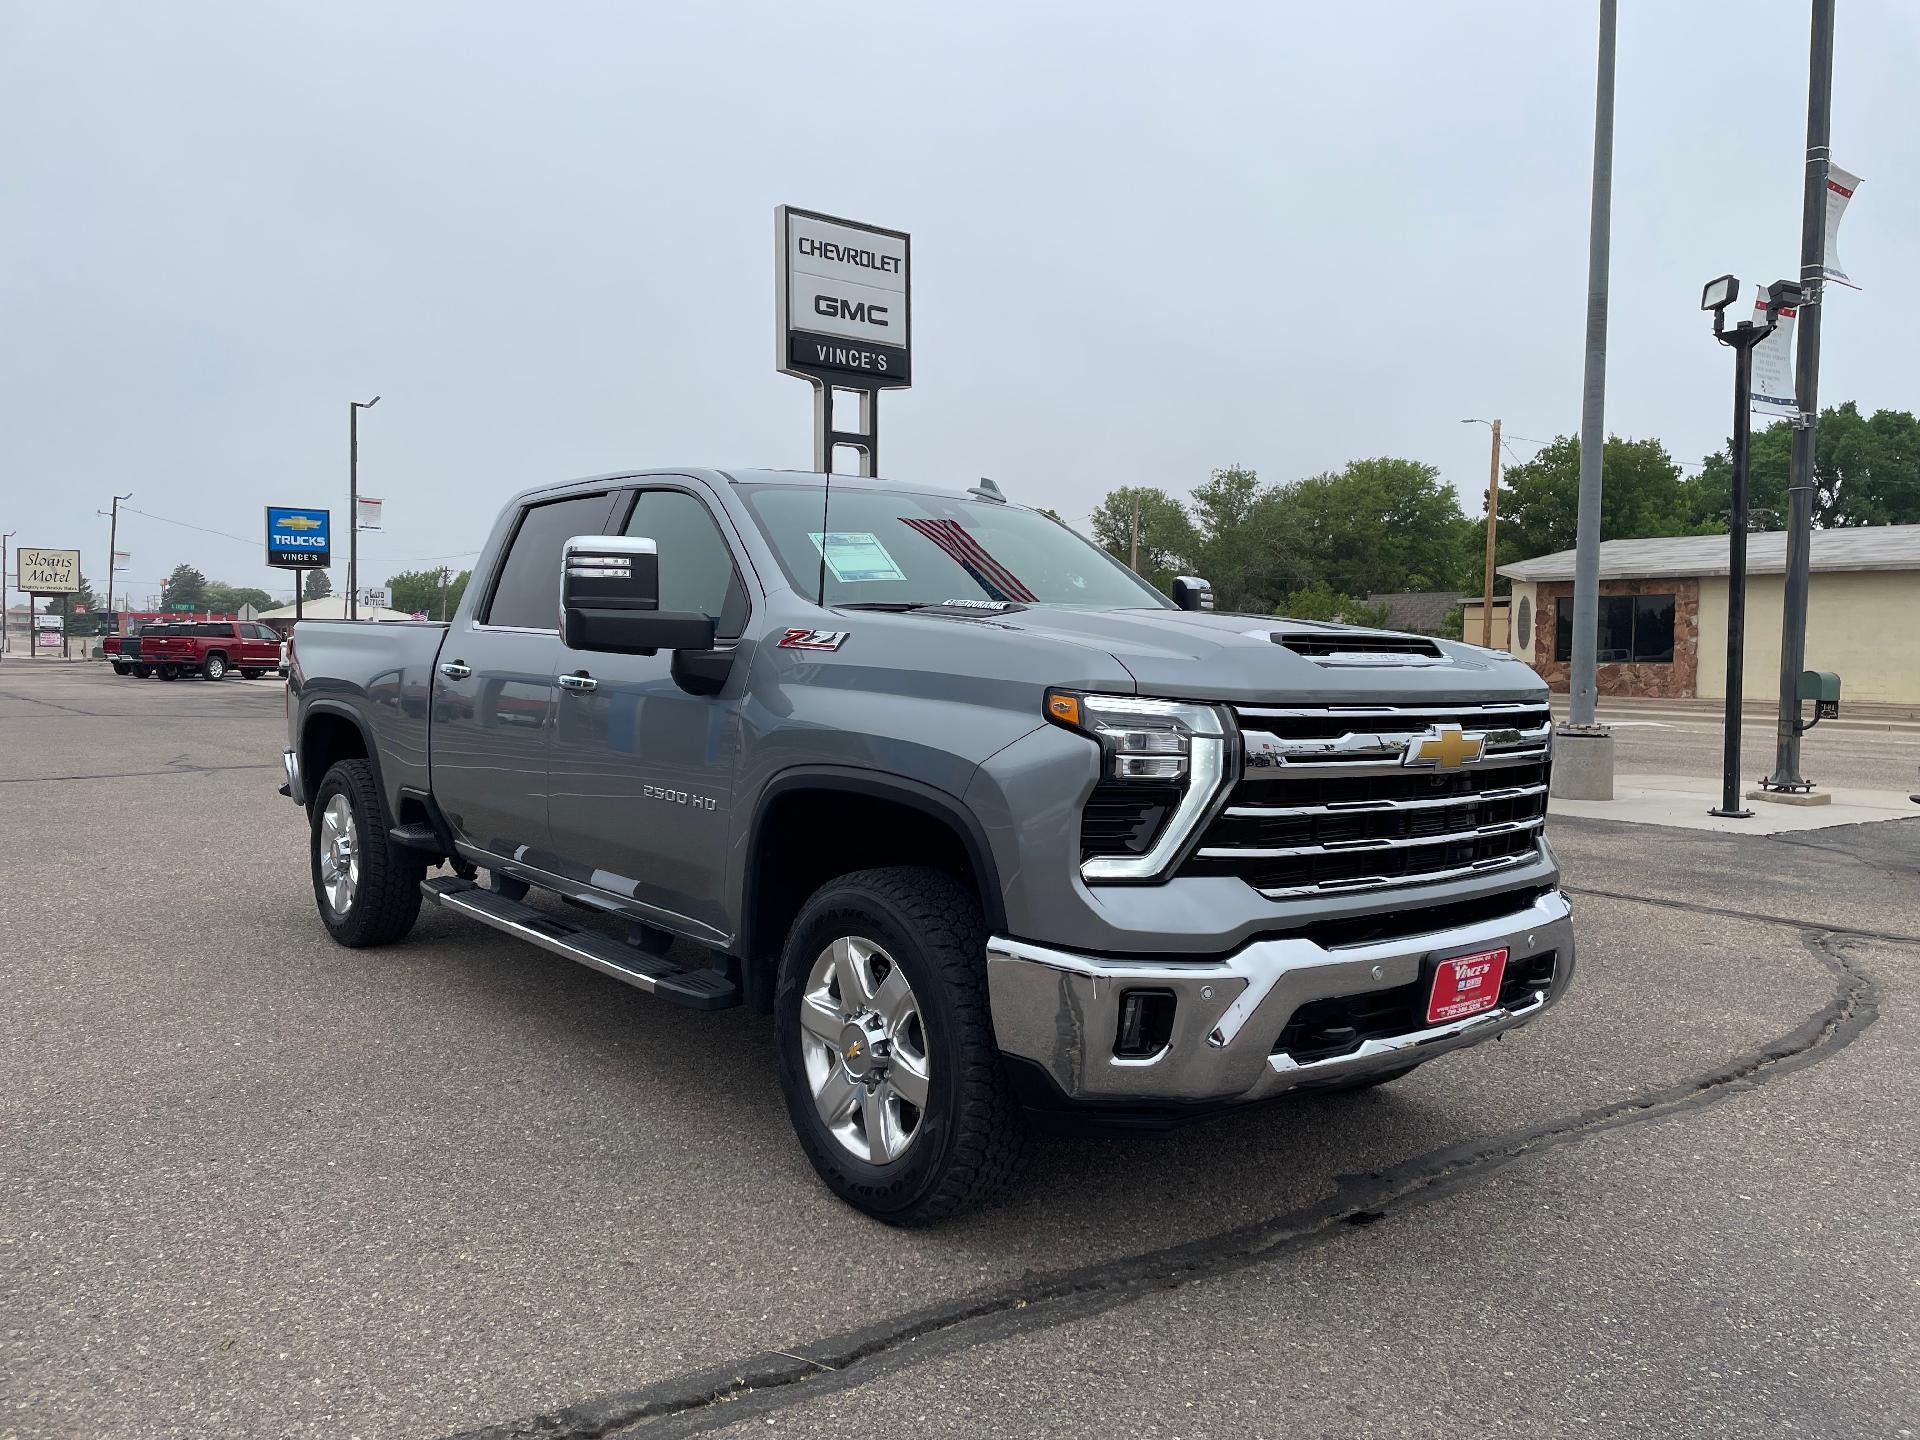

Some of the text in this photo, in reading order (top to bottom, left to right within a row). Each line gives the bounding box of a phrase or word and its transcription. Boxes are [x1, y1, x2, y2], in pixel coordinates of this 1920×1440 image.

[799, 237, 901, 273] CHEVROLET
[814, 294, 888, 327] GMC
[816, 345, 888, 371] VINCE'S
[273, 535, 326, 547] TRUCKS
[25, 552, 73, 568] Sloans
[282, 553, 318, 561] VINCE'S
[27, 569, 71, 583] Motel
[643, 784, 716, 811] 2500 HD
